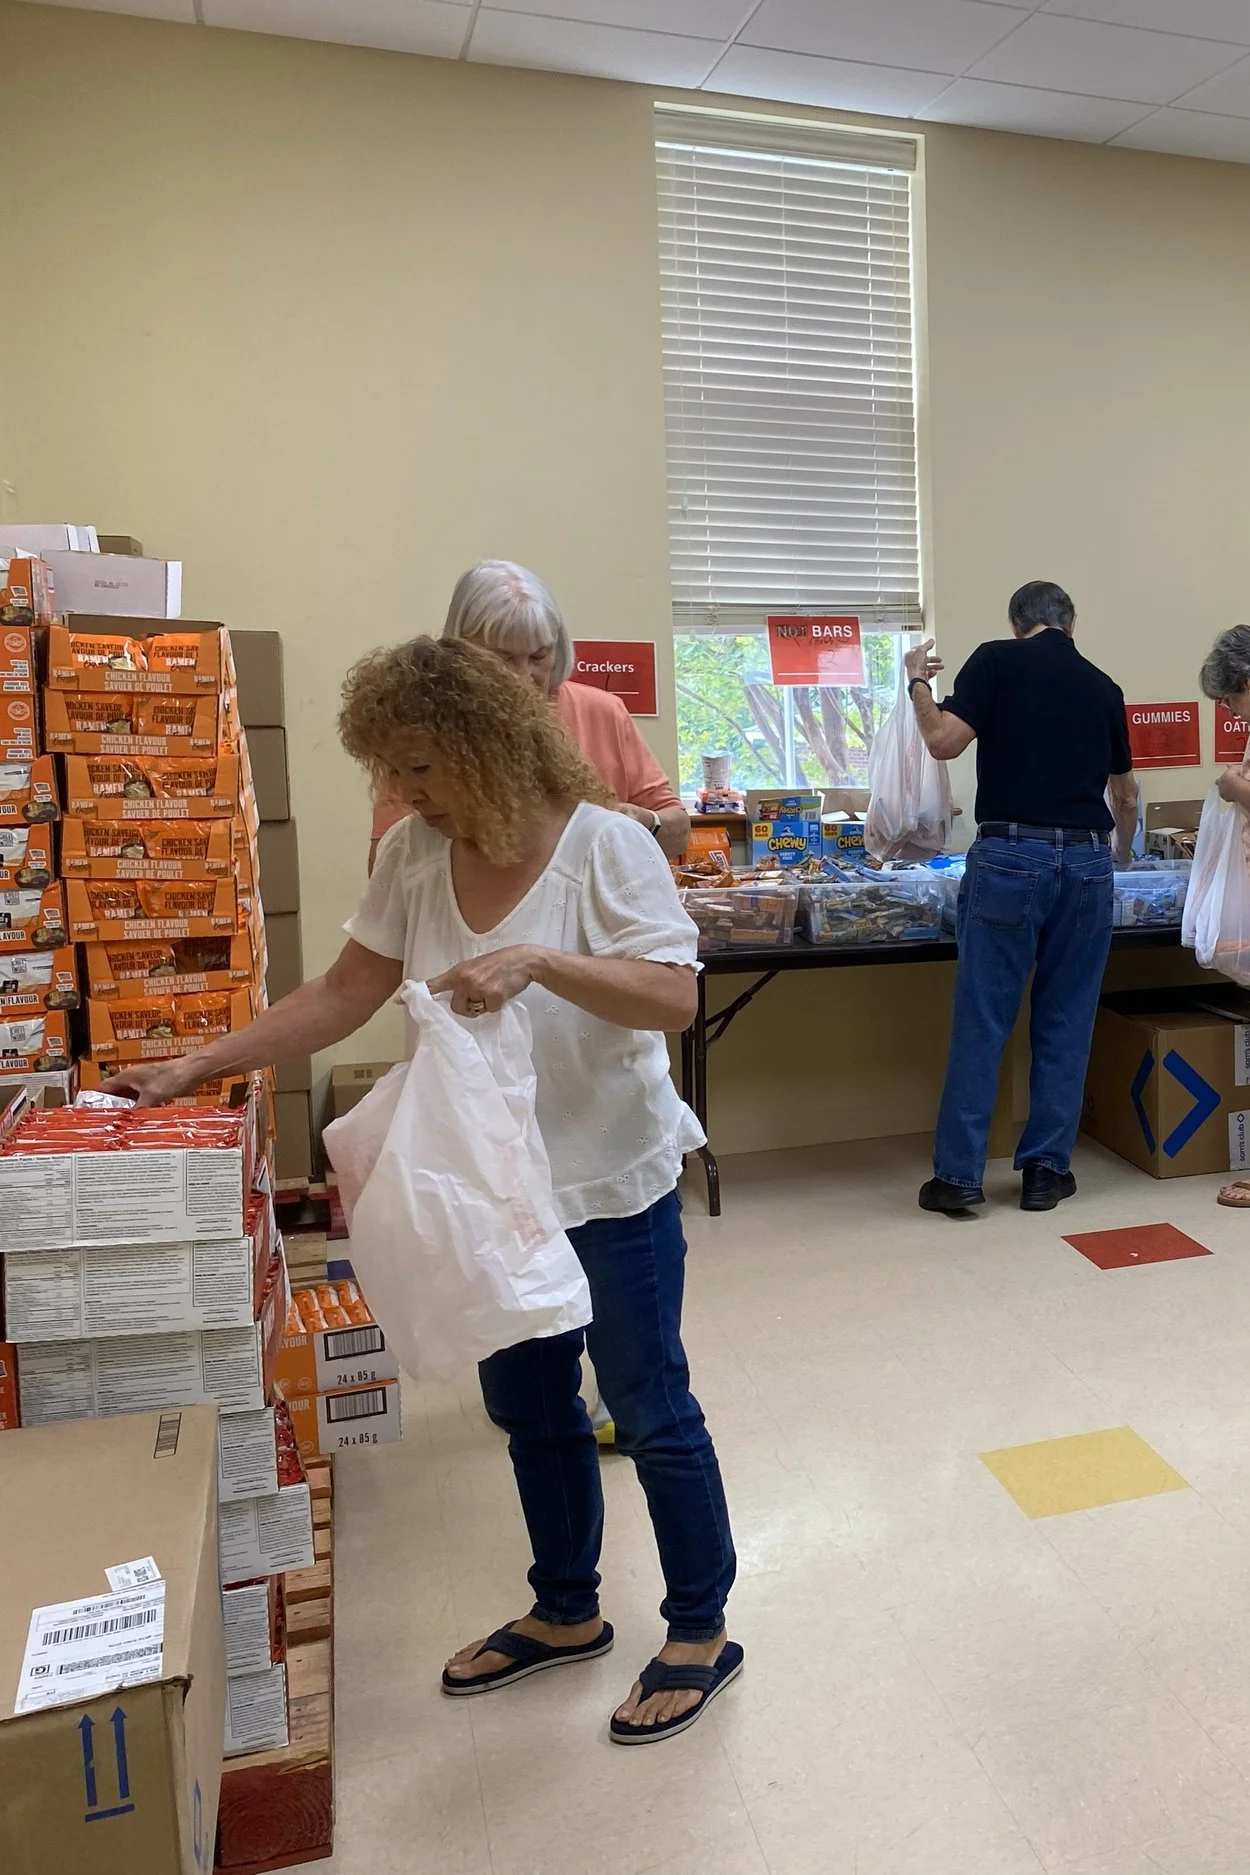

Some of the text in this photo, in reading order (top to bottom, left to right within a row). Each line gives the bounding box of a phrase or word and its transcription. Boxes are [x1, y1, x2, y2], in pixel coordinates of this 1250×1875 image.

[812, 626, 852, 637] BARS
[166, 658, 196, 666] RAMEN
[577, 661, 634, 673] Crackers
[105, 672, 170, 682] CHICKEN FLAVOUR
[135, 683, 144, 691] DE
[146, 683, 172, 692] POULET
[152, 715, 184, 723] FLAVOUR
[1132, 711, 1190, 724] GUMMIES
[1224, 721, 1250, 732] OAT
[102, 734, 166, 745] CHICKEN FLAVOUR
[131, 746, 140, 754] DE
[142, 746, 168, 755] POULET
[123, 800, 187, 809] CHICKEN FLAVOUR
[152, 809, 161, 818] DE
[163, 809, 189, 817] POULET
[825, 824, 837, 832] 60
[117, 860, 181, 869] CHICKEN FLAVOUR
[146, 870, 155, 878] DE
[157, 871, 183, 879] POULET
[105, 909, 135, 918] RAMEN
[125, 919, 188, 929] CHICKEN FLAVOUR
[153, 930, 162, 938] DE
[164, 928, 190, 937] POULET
[8, 995, 37, 1004] FLAVOUR
[181, 1046, 201, 1054] POULE
[337, 1375, 347, 1385] 24
[358, 1371, 367, 1381] 85
[371, 1371, 376, 1381] g
[339, 1437, 349, 1447] 24
[360, 1433, 369, 1443] 85
[373, 1433, 378, 1443] g
